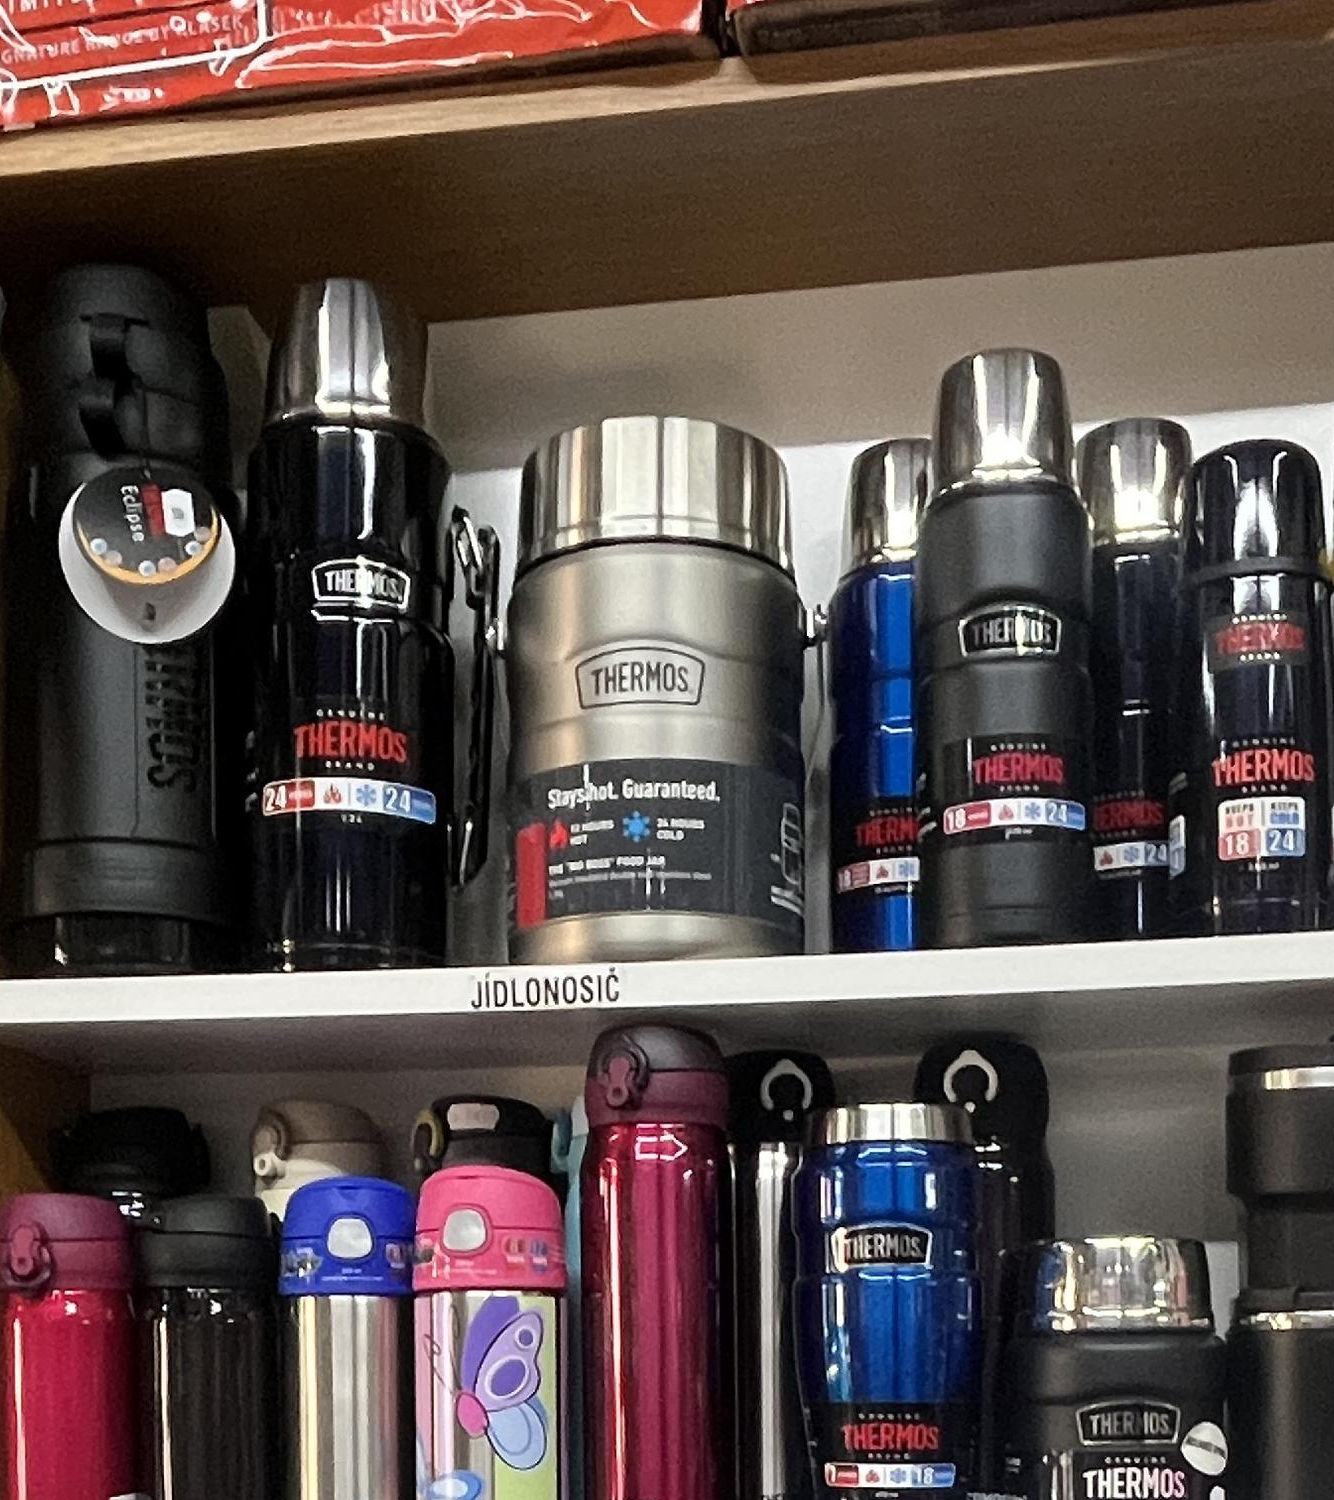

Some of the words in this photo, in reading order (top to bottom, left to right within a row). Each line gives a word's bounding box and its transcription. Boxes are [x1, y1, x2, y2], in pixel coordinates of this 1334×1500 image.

[119, 484, 145, 543] Eclipse
[590, 661, 691, 697] THERMOS
[293, 719, 409, 764] THERMOS
[972, 752, 1065, 786] THERMOS
[1211, 748, 1317, 787] THERMOS
[265, 784, 288, 812] 24
[384, 787, 412, 813] 24
[621, 777, 722, 804] Guaranteed.
[946, 807, 967, 832] 18
[1046, 802, 1068, 824] 24
[1223, 831, 1250, 857] 18
[1269, 829, 1296, 853] 24
[470, 967, 621, 1010] JÍDLONOSIČ
[845, 1232, 924, 1259] THERMOS
[841, 1422, 940, 1453] THERMOS
[1082, 1465, 1186, 1500] THERMOS
